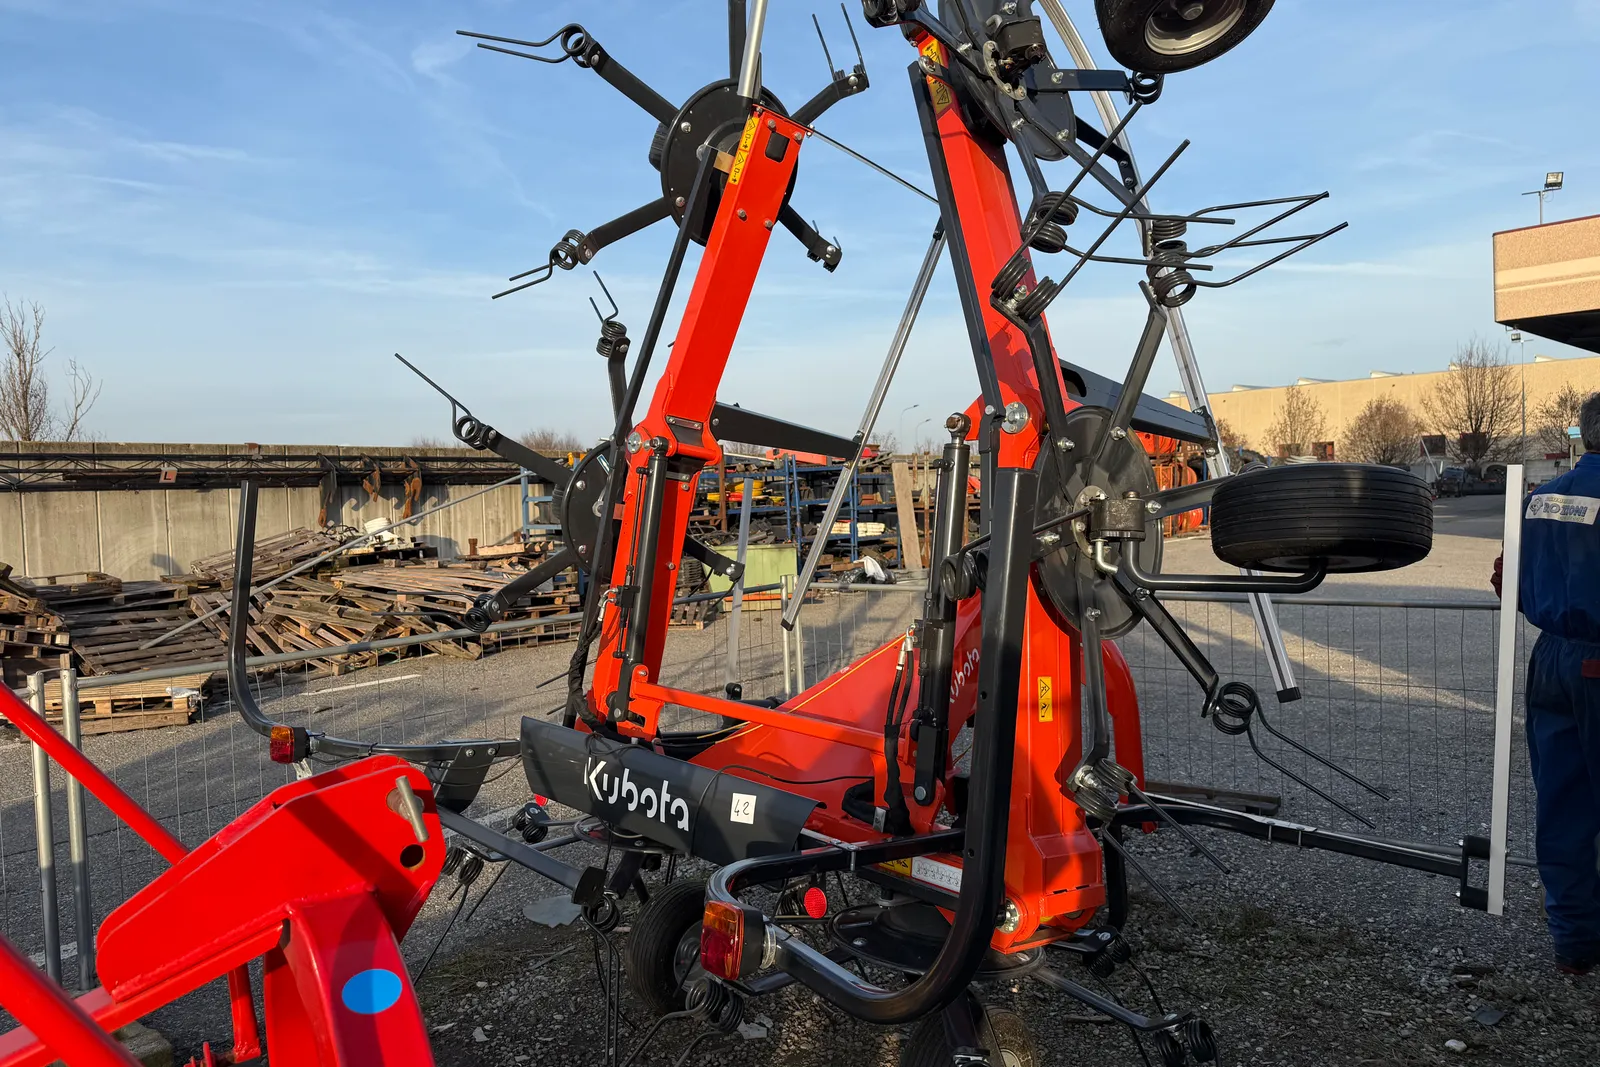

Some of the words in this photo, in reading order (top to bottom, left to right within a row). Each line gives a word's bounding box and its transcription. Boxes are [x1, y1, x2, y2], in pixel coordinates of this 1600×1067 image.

[950, 648, 980, 704] ubota
[584, 757, 689, 832] Kubota
[733, 799, 750, 817] 42
